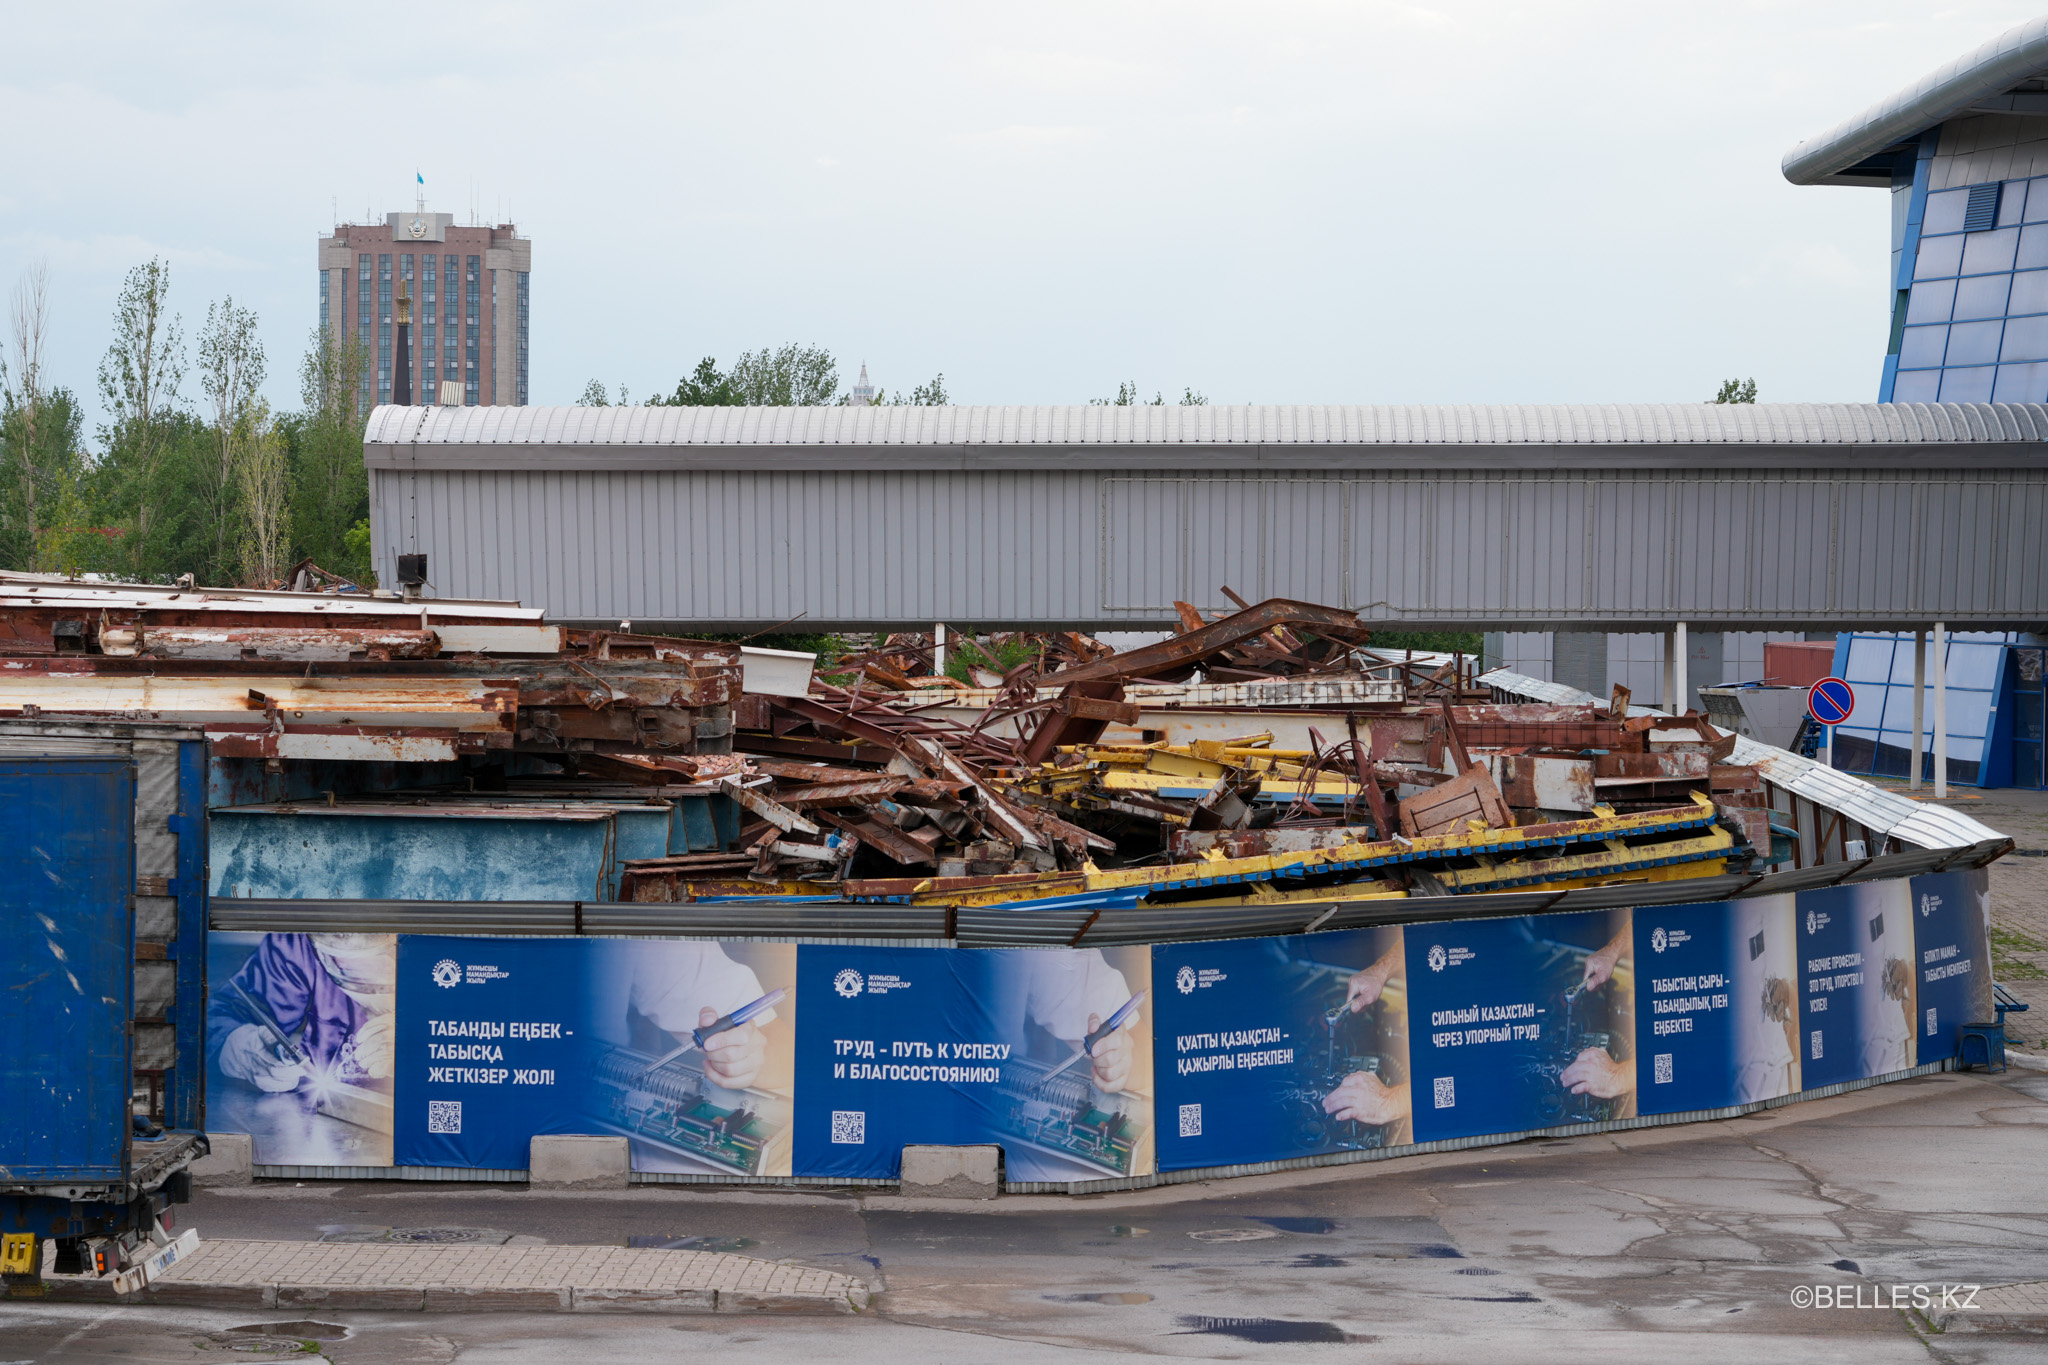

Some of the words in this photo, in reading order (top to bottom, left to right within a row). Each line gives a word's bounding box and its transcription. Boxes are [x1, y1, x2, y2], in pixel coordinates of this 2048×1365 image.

[1808, 957, 1831, 973] РАБОЧИЕ
[1831, 952, 1861, 969] ПРОФЕССИИ
[868, 981, 911, 989] МАМАНДЫҚТАР
[1652, 976, 1698, 993] ТАБЫСТЫҢ
[1699, 973, 1723, 989] СЫРЫ
[1809, 979, 1819, 993] ЭТО
[1819, 976, 1834, 992] ТРУД,
[1834, 972, 1859, 989] УПОРСТВО
[1653, 996, 1711, 1014] ТАБАНДЫЛЫҚ
[1712, 994, 1728, 1008] ПЕН
[1809, 997, 1828, 1013] УСПЕХ!
[1432, 1005, 1479, 1026] СИЛЬНЫЙ
[1481, 1003, 1534, 1022] КАЗАХСТАН
[429, 1020, 505, 1040] ТАБАНДЫ
[509, 1022, 562, 1041] ЕҢБЕК
[1432, 1031, 1463, 1048] ЧЕРЕЗ
[1465, 1023, 1511, 1045] УПОРНЫЙ
[1513, 1024, 1540, 1041] ТРУД!
[1654, 1018, 1693, 1037] ЕҢБЕКТЕ!
[834, 1040, 875, 1059] ТРУД
[892, 1042, 933, 1058] ПУТЬ
[938, 1043, 949, 1058] К
[953, 1043, 1011, 1059] УСПЕХУ
[1177, 1033, 1218, 1053] ҚУАТТЫ
[1221, 1027, 1280, 1050] ҚАЗАҚСТАН
[428, 1044, 503, 1063] ТАБЫСҚА
[1178, 1054, 1235, 1076] ҚАЖЫРЛЫ
[1237, 1049, 1293, 1070] ЕҢБЕКПЕН!
[428, 1067, 508, 1084] ЖЕТКІЗЕР
[512, 1069, 555, 1085] ЖОЛ!
[834, 1063, 845, 1078] И
[850, 1064, 1000, 1082] БЛАГОСОСТОЯНИЮ!
